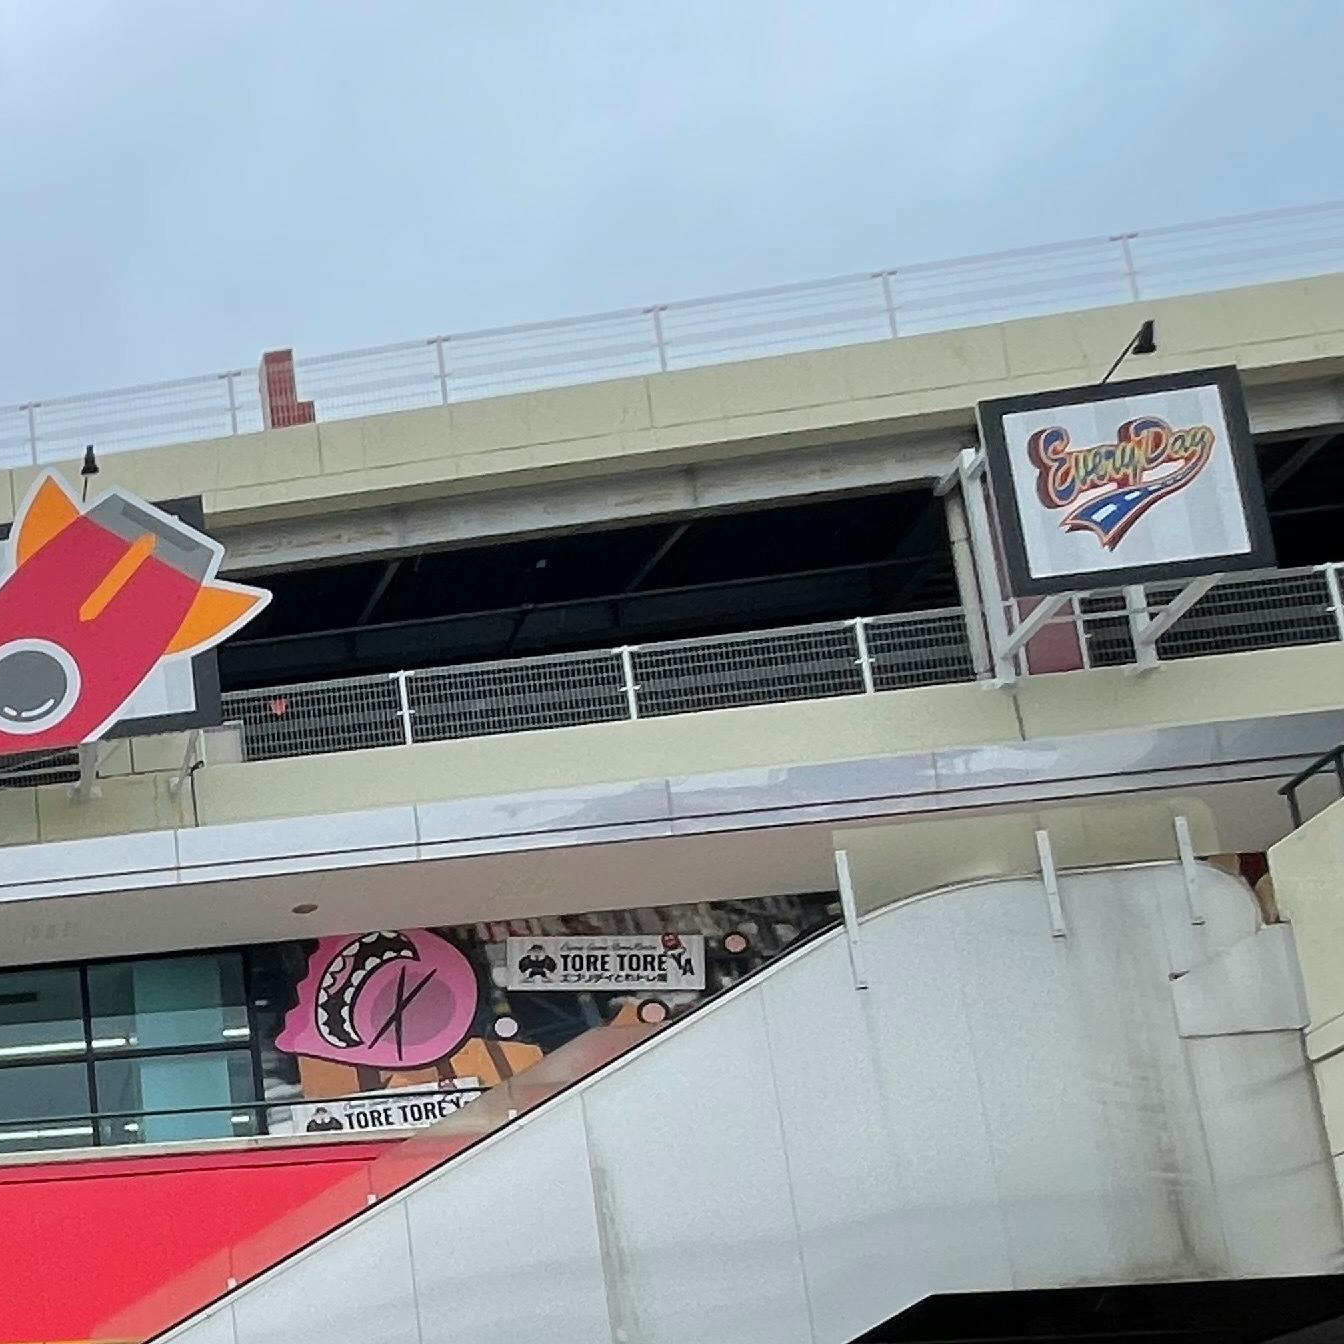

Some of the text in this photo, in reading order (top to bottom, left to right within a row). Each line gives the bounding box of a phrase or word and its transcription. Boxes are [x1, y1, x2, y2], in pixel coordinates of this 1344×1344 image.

[559, 953, 610, 972] TORE
[616, 953, 668, 972] TORE
[345, 1108, 394, 1130] TORE
[397, 1099, 447, 1123] TORE
